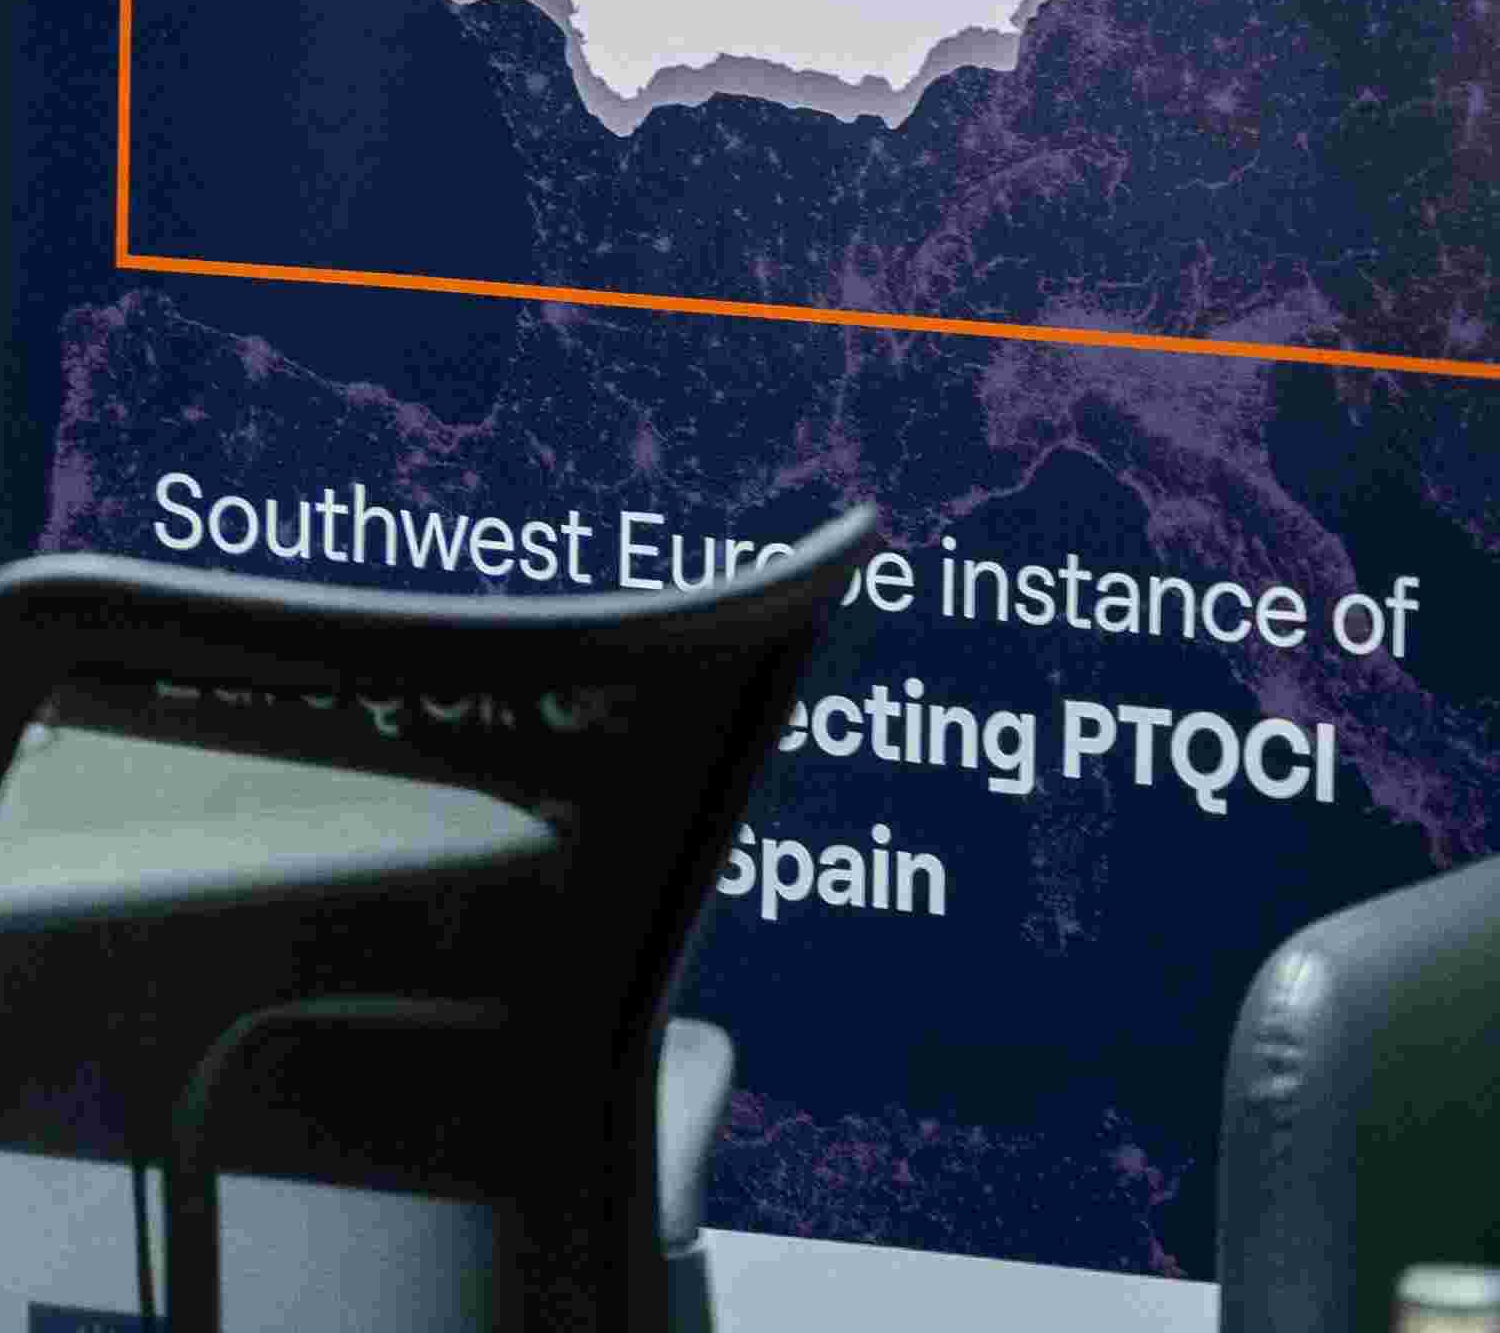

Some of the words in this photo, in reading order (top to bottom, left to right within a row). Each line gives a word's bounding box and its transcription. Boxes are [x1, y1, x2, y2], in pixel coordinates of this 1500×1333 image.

[153, 472, 593, 584] Southwest
[619, 509, 915, 613] Eure
[941, 535, 1308, 652] instance
[1333, 576, 1419, 659] of
[1063, 699, 1336, 815] PTQCI
